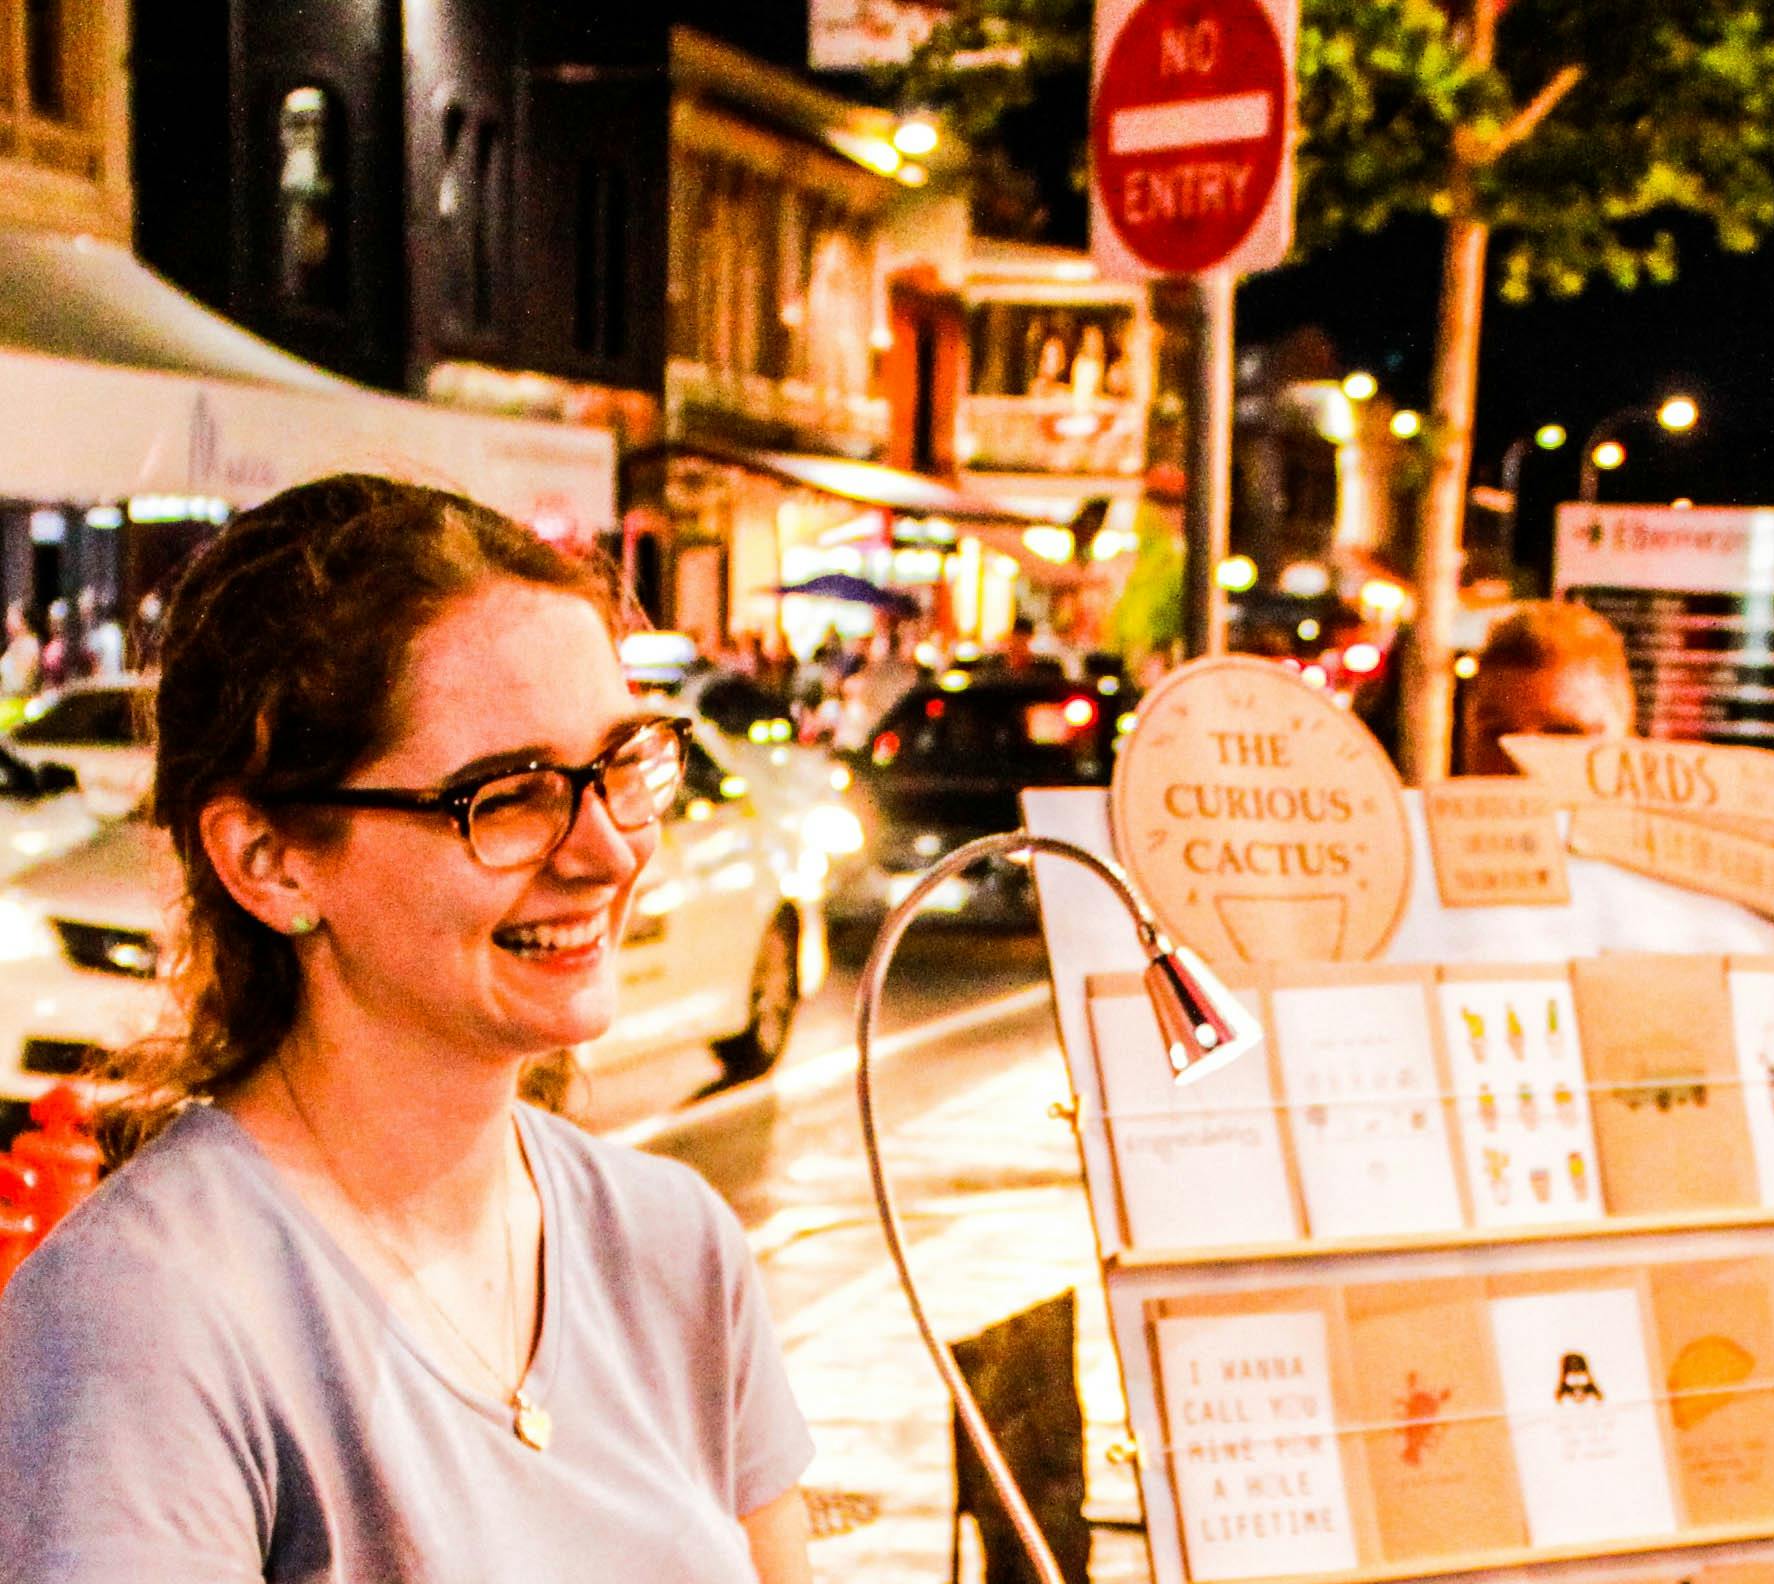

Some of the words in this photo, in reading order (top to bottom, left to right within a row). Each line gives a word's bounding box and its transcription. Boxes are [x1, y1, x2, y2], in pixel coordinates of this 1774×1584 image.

[1159, 18, 1219, 77] NO
[1123, 162, 1253, 224] ENTRY
[1209, 733, 1291, 768] THE
[1584, 743, 1720, 807] CARDS
[1163, 782, 1354, 823] CURIOUS
[1181, 838, 1352, 877] CACTUS
[1220, 1356, 1305, 1382] WANNA
[1183, 1398, 1251, 1426] CALL
[1201, 1508, 1337, 1543] LIFETIME
